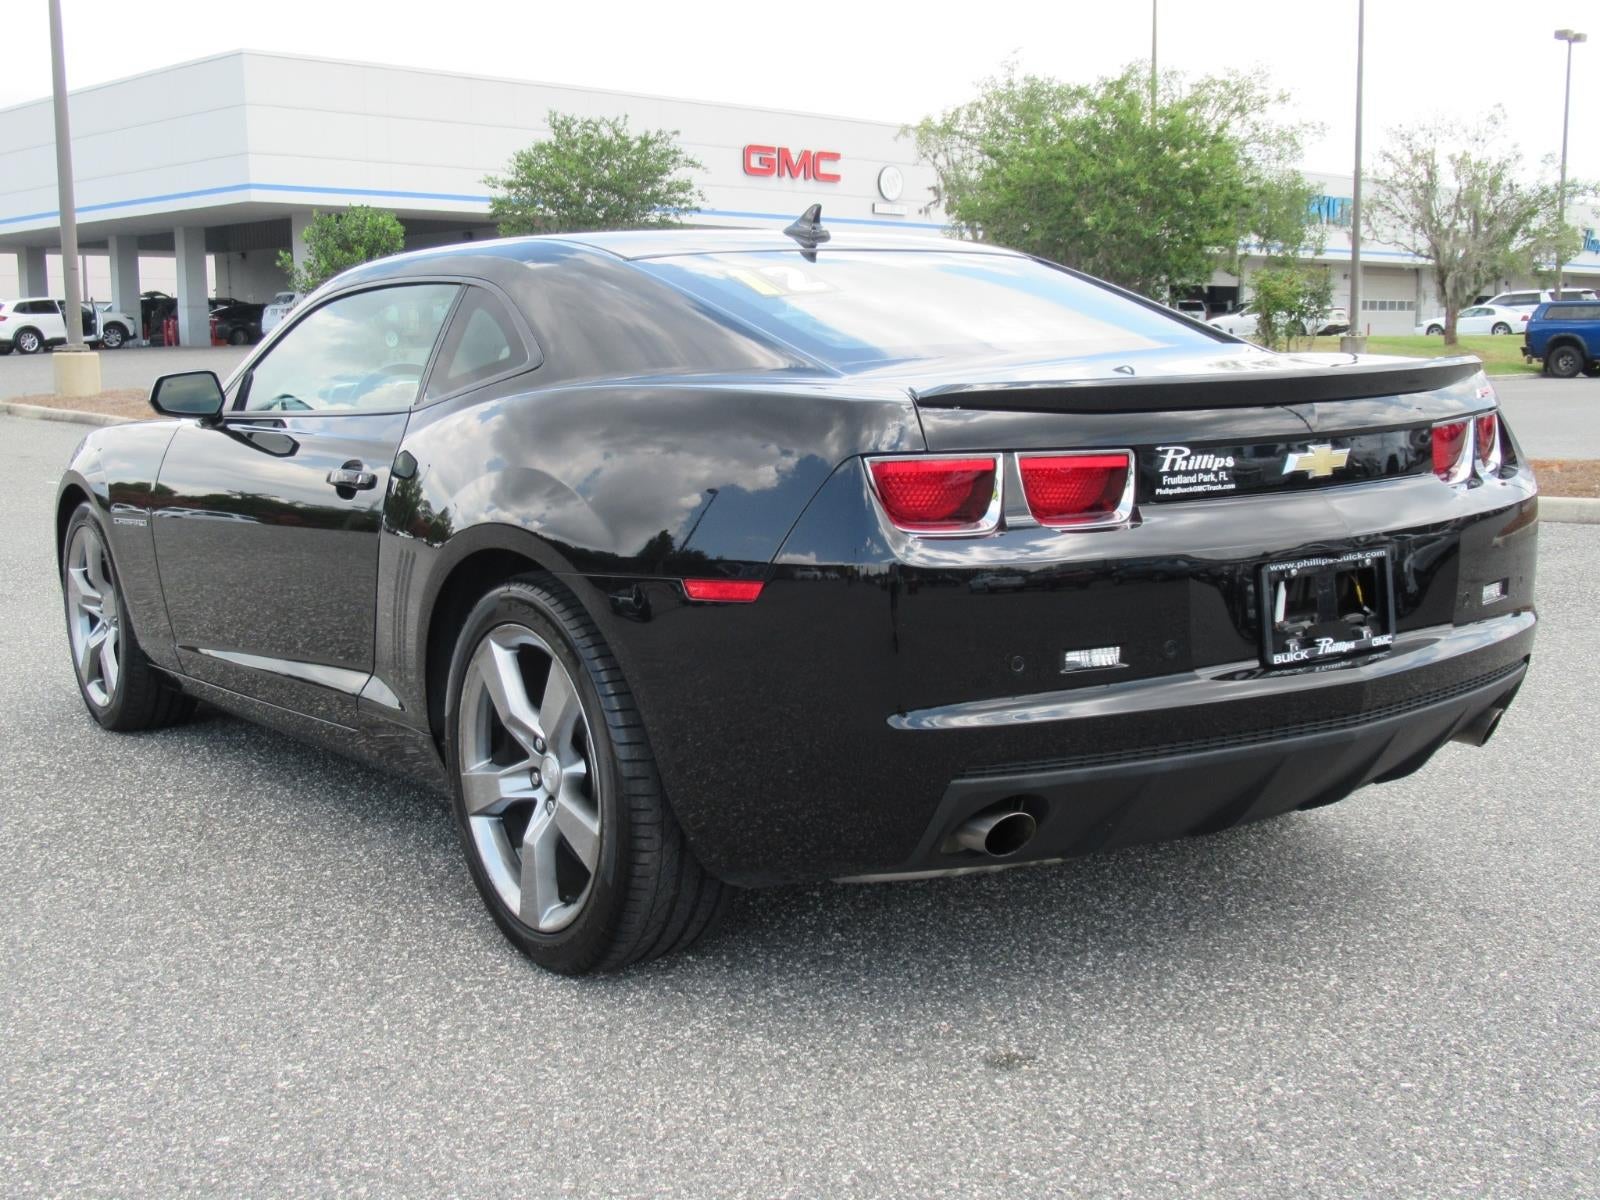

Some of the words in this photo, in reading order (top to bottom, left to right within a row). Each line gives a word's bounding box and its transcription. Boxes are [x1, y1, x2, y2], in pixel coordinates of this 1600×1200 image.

[743, 144, 841, 183] GMC
[1155, 446, 1235, 472] Phillips
[1163, 473, 1197, 485] Fruitland
[1198, 472, 1217, 482] Park,
[1219, 471, 1229, 481] FL
[1273, 651, 1310, 664] BUICK
[1314, 637, 1356, 655] Phillips
[1371, 635, 1393, 647] GMC
